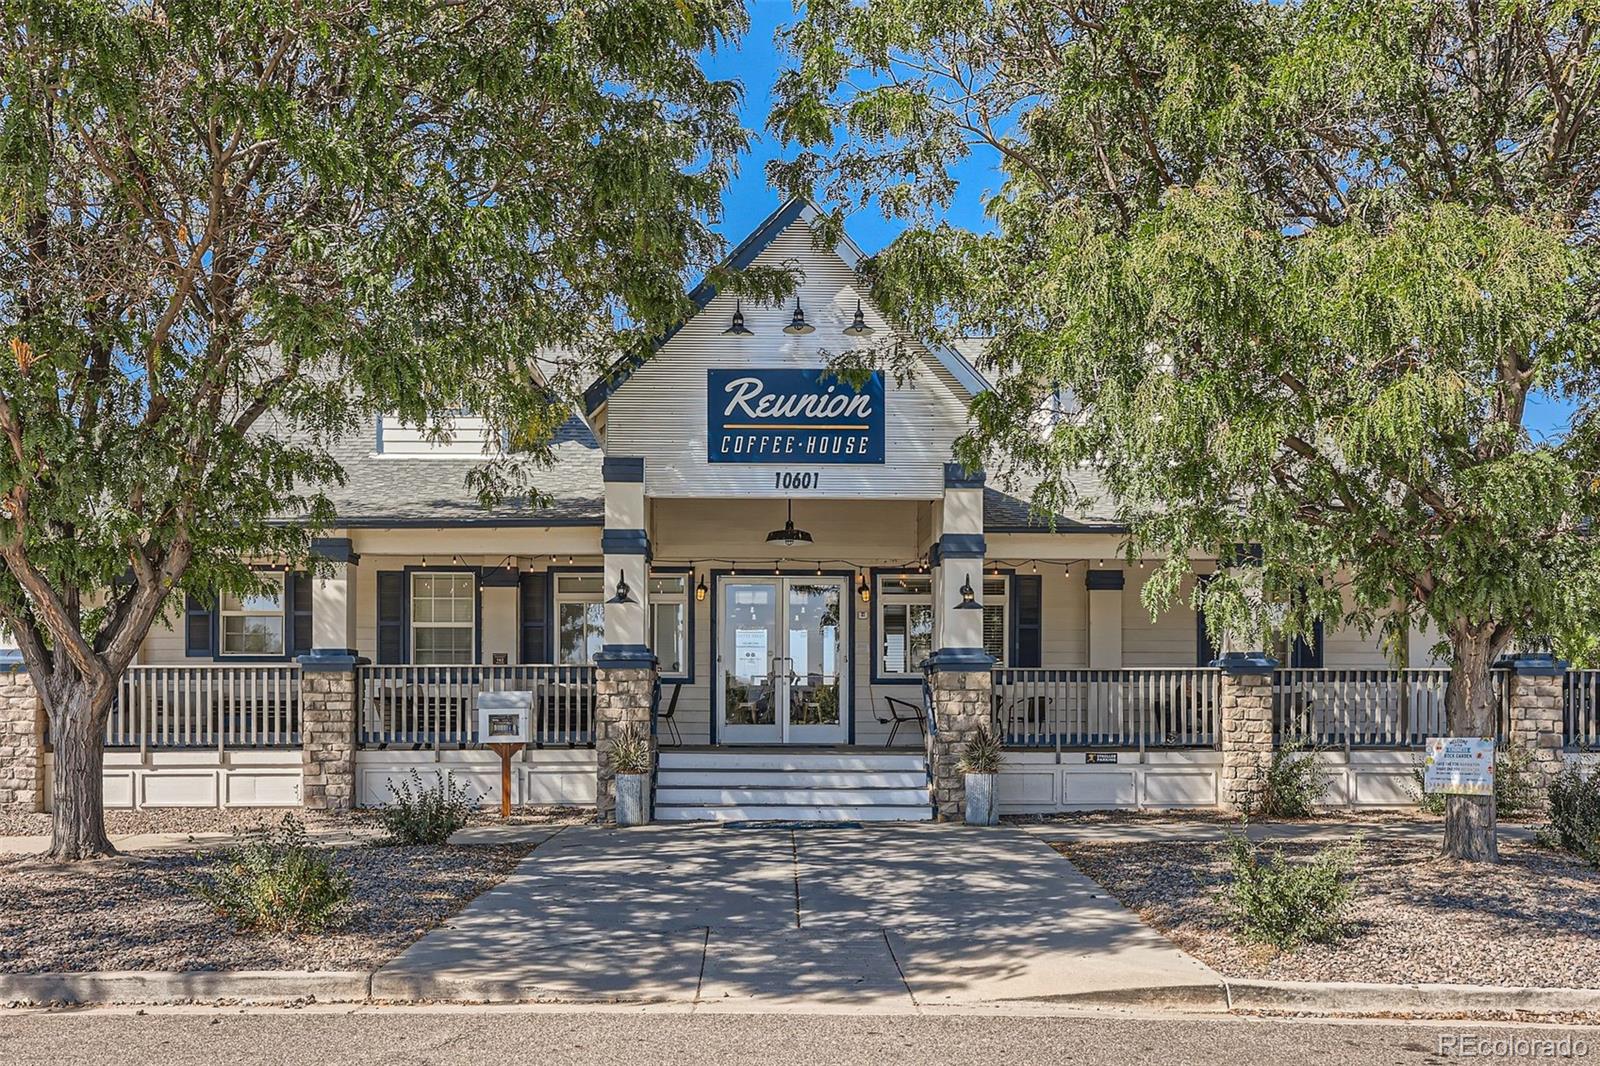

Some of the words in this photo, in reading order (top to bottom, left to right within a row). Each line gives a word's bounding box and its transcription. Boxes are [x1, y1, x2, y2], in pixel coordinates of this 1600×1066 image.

[724, 377, 872, 418] Reunion
[721, 436, 795, 454] COFFEE
[806, 437, 869, 454] HOUSE
[775, 472, 819, 489] 10601
